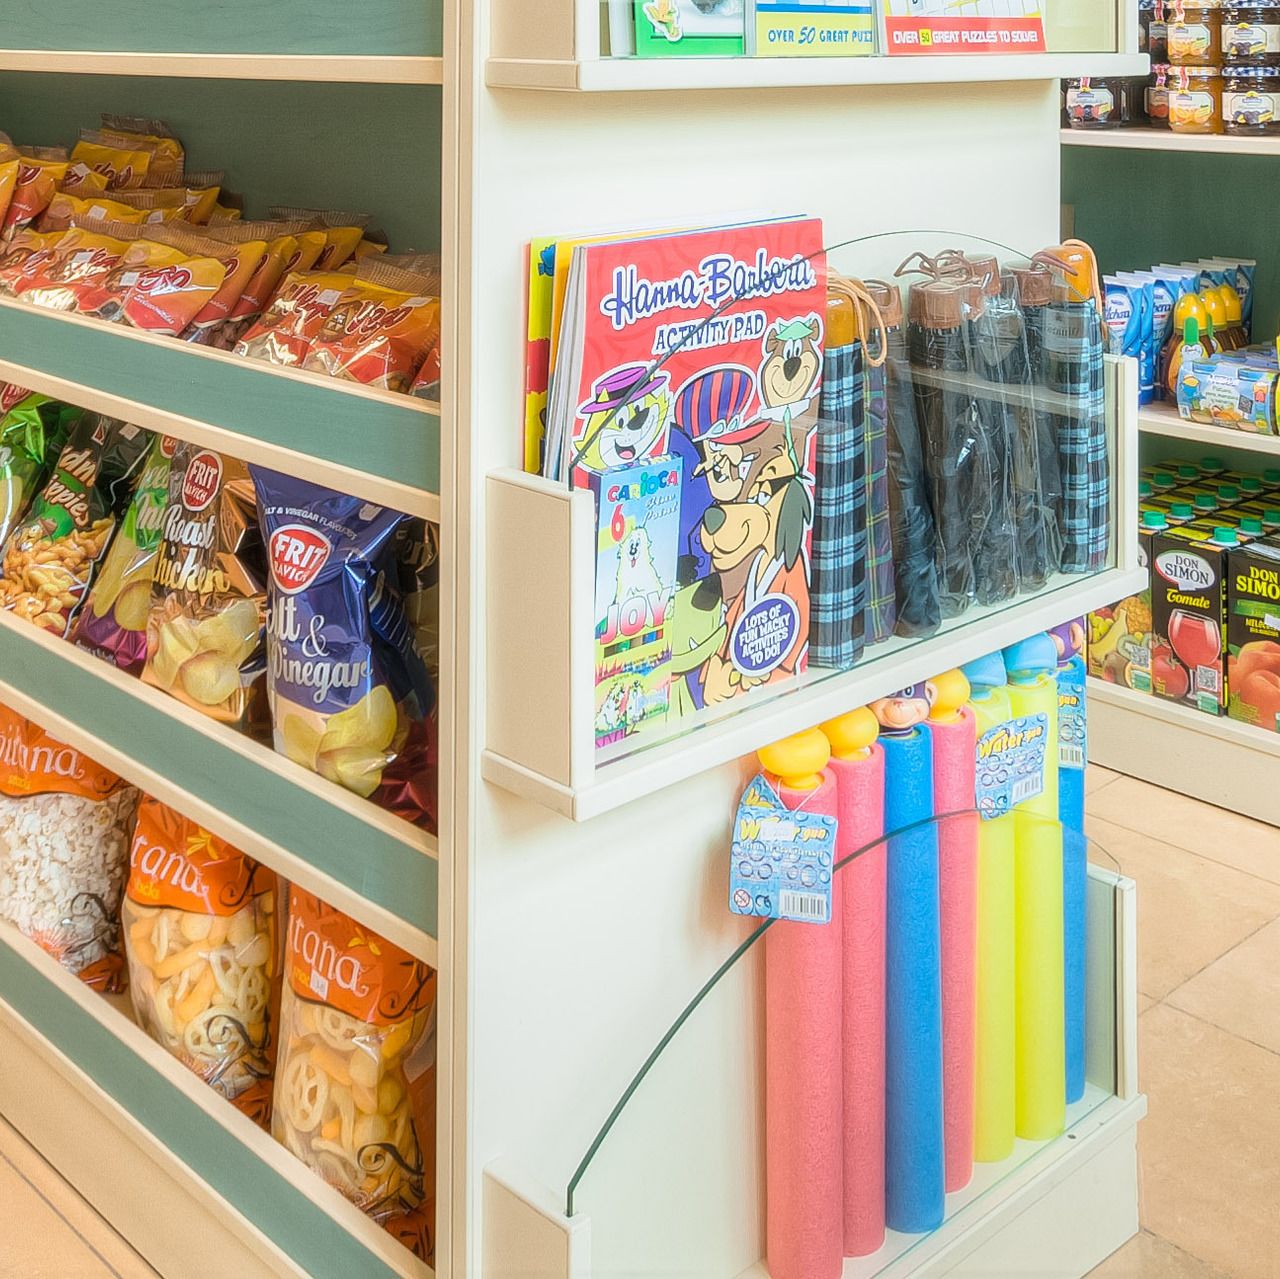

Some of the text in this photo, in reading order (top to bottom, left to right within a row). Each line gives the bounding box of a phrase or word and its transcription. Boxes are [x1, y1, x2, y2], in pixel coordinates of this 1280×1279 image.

[769, 27, 848, 44] OVER 50 GREAT
[893, 31, 1010, 43] OVER 50 GREAT PUZZLES TO
[655, 312, 765, 352] ACTIVITY PAD
[190, 458, 218, 491] FRIT
[164, 504, 215, 550] Roast
[285, 507, 319, 522] VINEGAR
[611, 504, 625, 541] 6
[276, 533, 328, 571] FRIT
[1175, 555, 1199, 570] DON
[1249, 567, 1278, 584] DON
[1166, 588, 1210, 609] Tomate
[601, 586, 673, 644] JOY
[739, 613, 790, 646] FUN WACKY
[744, 605, 782, 628] LOTS OF
[301, 615, 330, 658] &
[742, 628, 789, 657] ACTIVITIES
[751, 645, 782, 666] TO DO!
[978, 727, 1043, 759] Water gun
